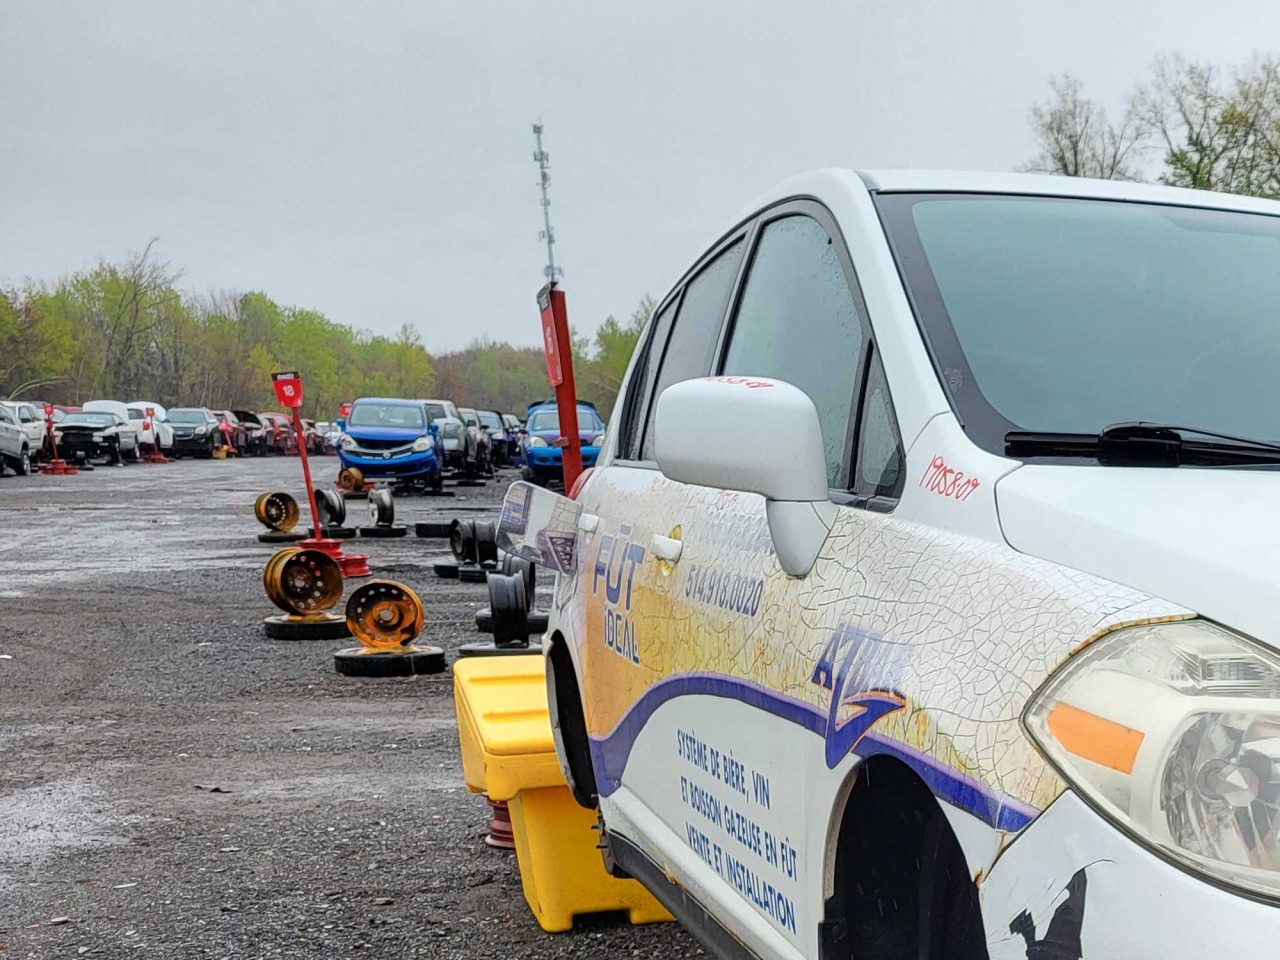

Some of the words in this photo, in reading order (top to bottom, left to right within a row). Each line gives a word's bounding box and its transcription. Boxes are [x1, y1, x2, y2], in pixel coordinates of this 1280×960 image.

[677, 727, 708, 772] SYSTÈME
[710, 747, 721, 780] DE
[723, 748, 750, 803] BIÈRE,
[751, 769, 771, 810] VIN
[680, 775, 689, 803] ET
[689, 780, 723, 829] BOISSON
[723, 804, 763, 857] GAZEUSE
[764, 831, 778, 868] EN
[780, 836, 798, 882] FÛT
[685, 821, 712, 866] VENTE
[713, 843, 723, 877] ET
[725, 851, 797, 935] INSTALLATION
